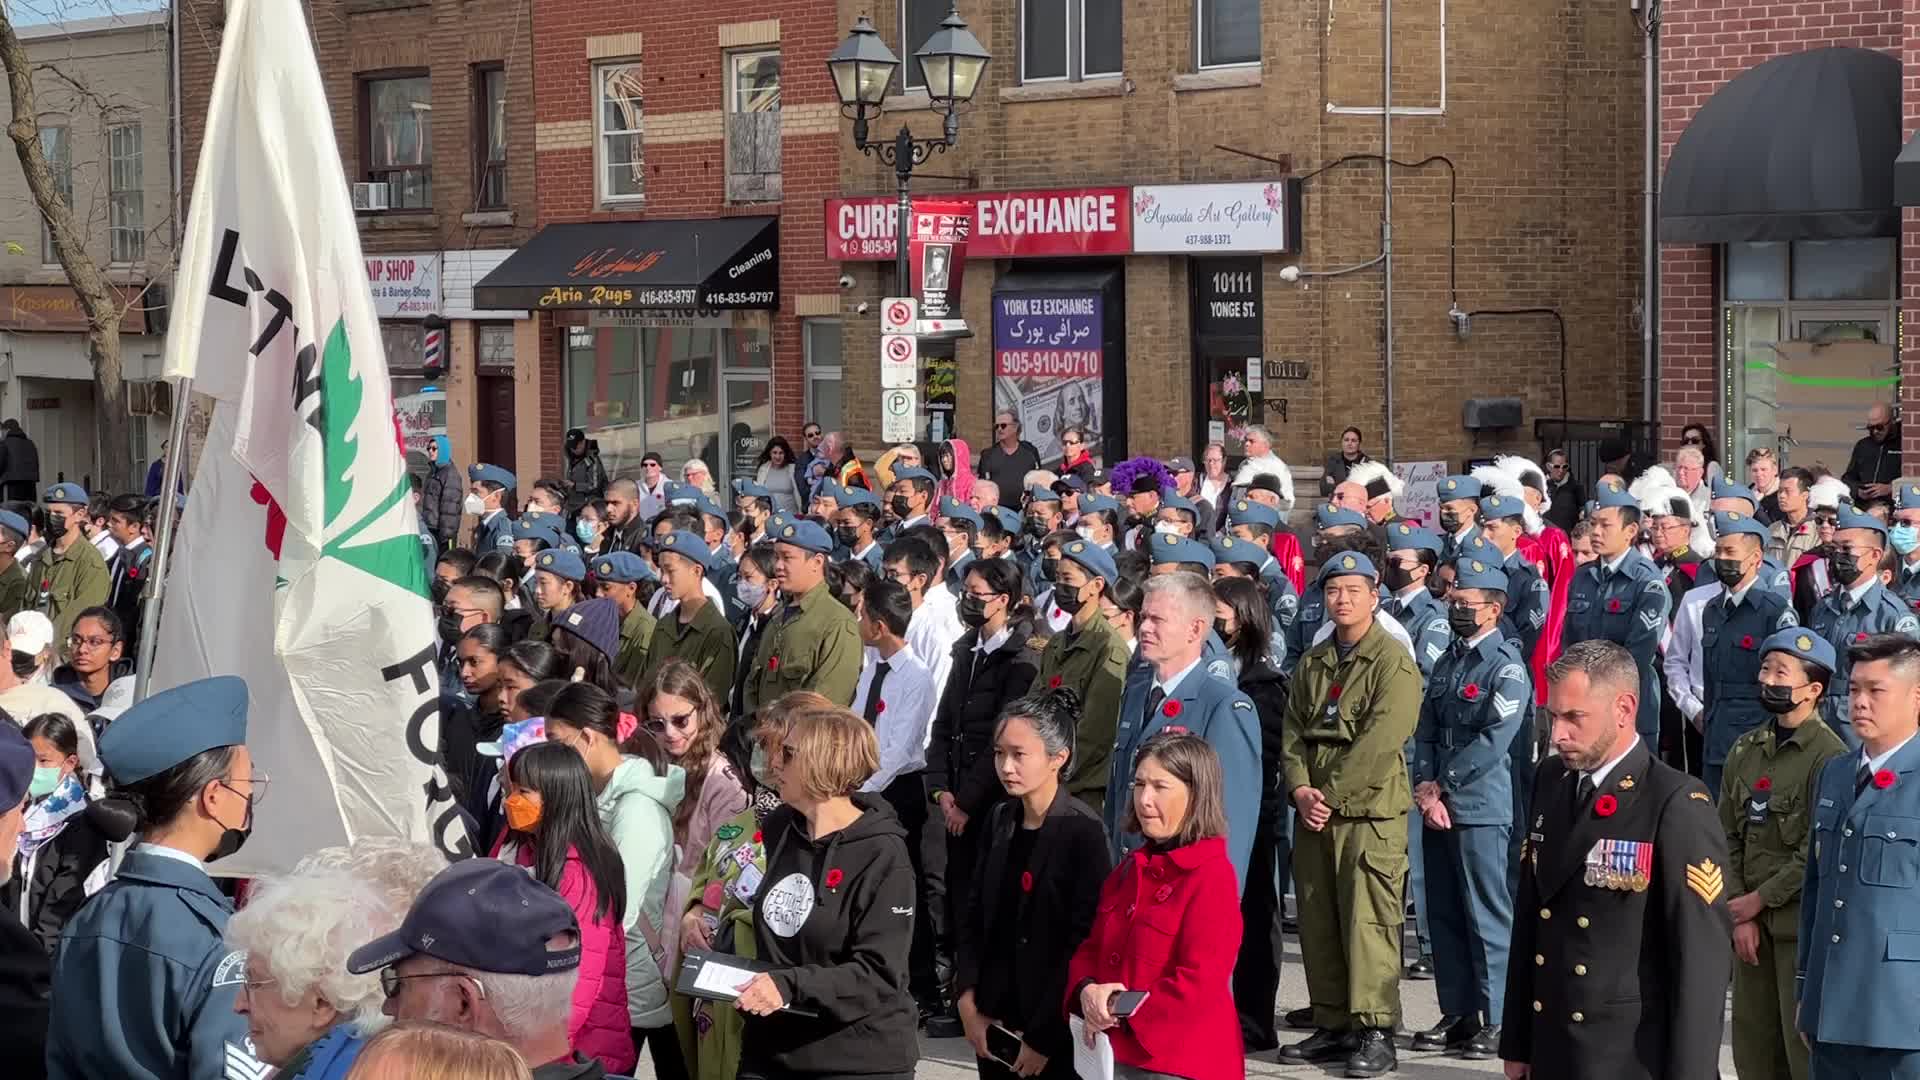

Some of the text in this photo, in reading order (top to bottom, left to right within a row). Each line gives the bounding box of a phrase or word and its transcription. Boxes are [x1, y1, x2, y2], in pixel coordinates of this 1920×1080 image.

[838, 195, 1116, 240] CURR EXCHANGE
[1197, 201, 1221, 223] Art
[1224, 199, 1274, 229] Gallery
[862, 240, 897, 254] 905-91
[386, 259, 415, 281] SHOP
[729, 248, 773, 279] Cleaning
[1212, 272, 1252, 293] 10111
[540, 286, 697, 306] Aria Rugs 416-835-9797
[706, 291, 774, 304] 416-835-9797
[1003, 298, 1094, 316] YORK EZ EXCHANGE
[1210, 301, 1256, 318] YONGE ST.
[1048, 317, 1090, 346] صرافی
[1002, 351, 1098, 374] 905-910-0710
[740, 437, 759, 448] OPEN
